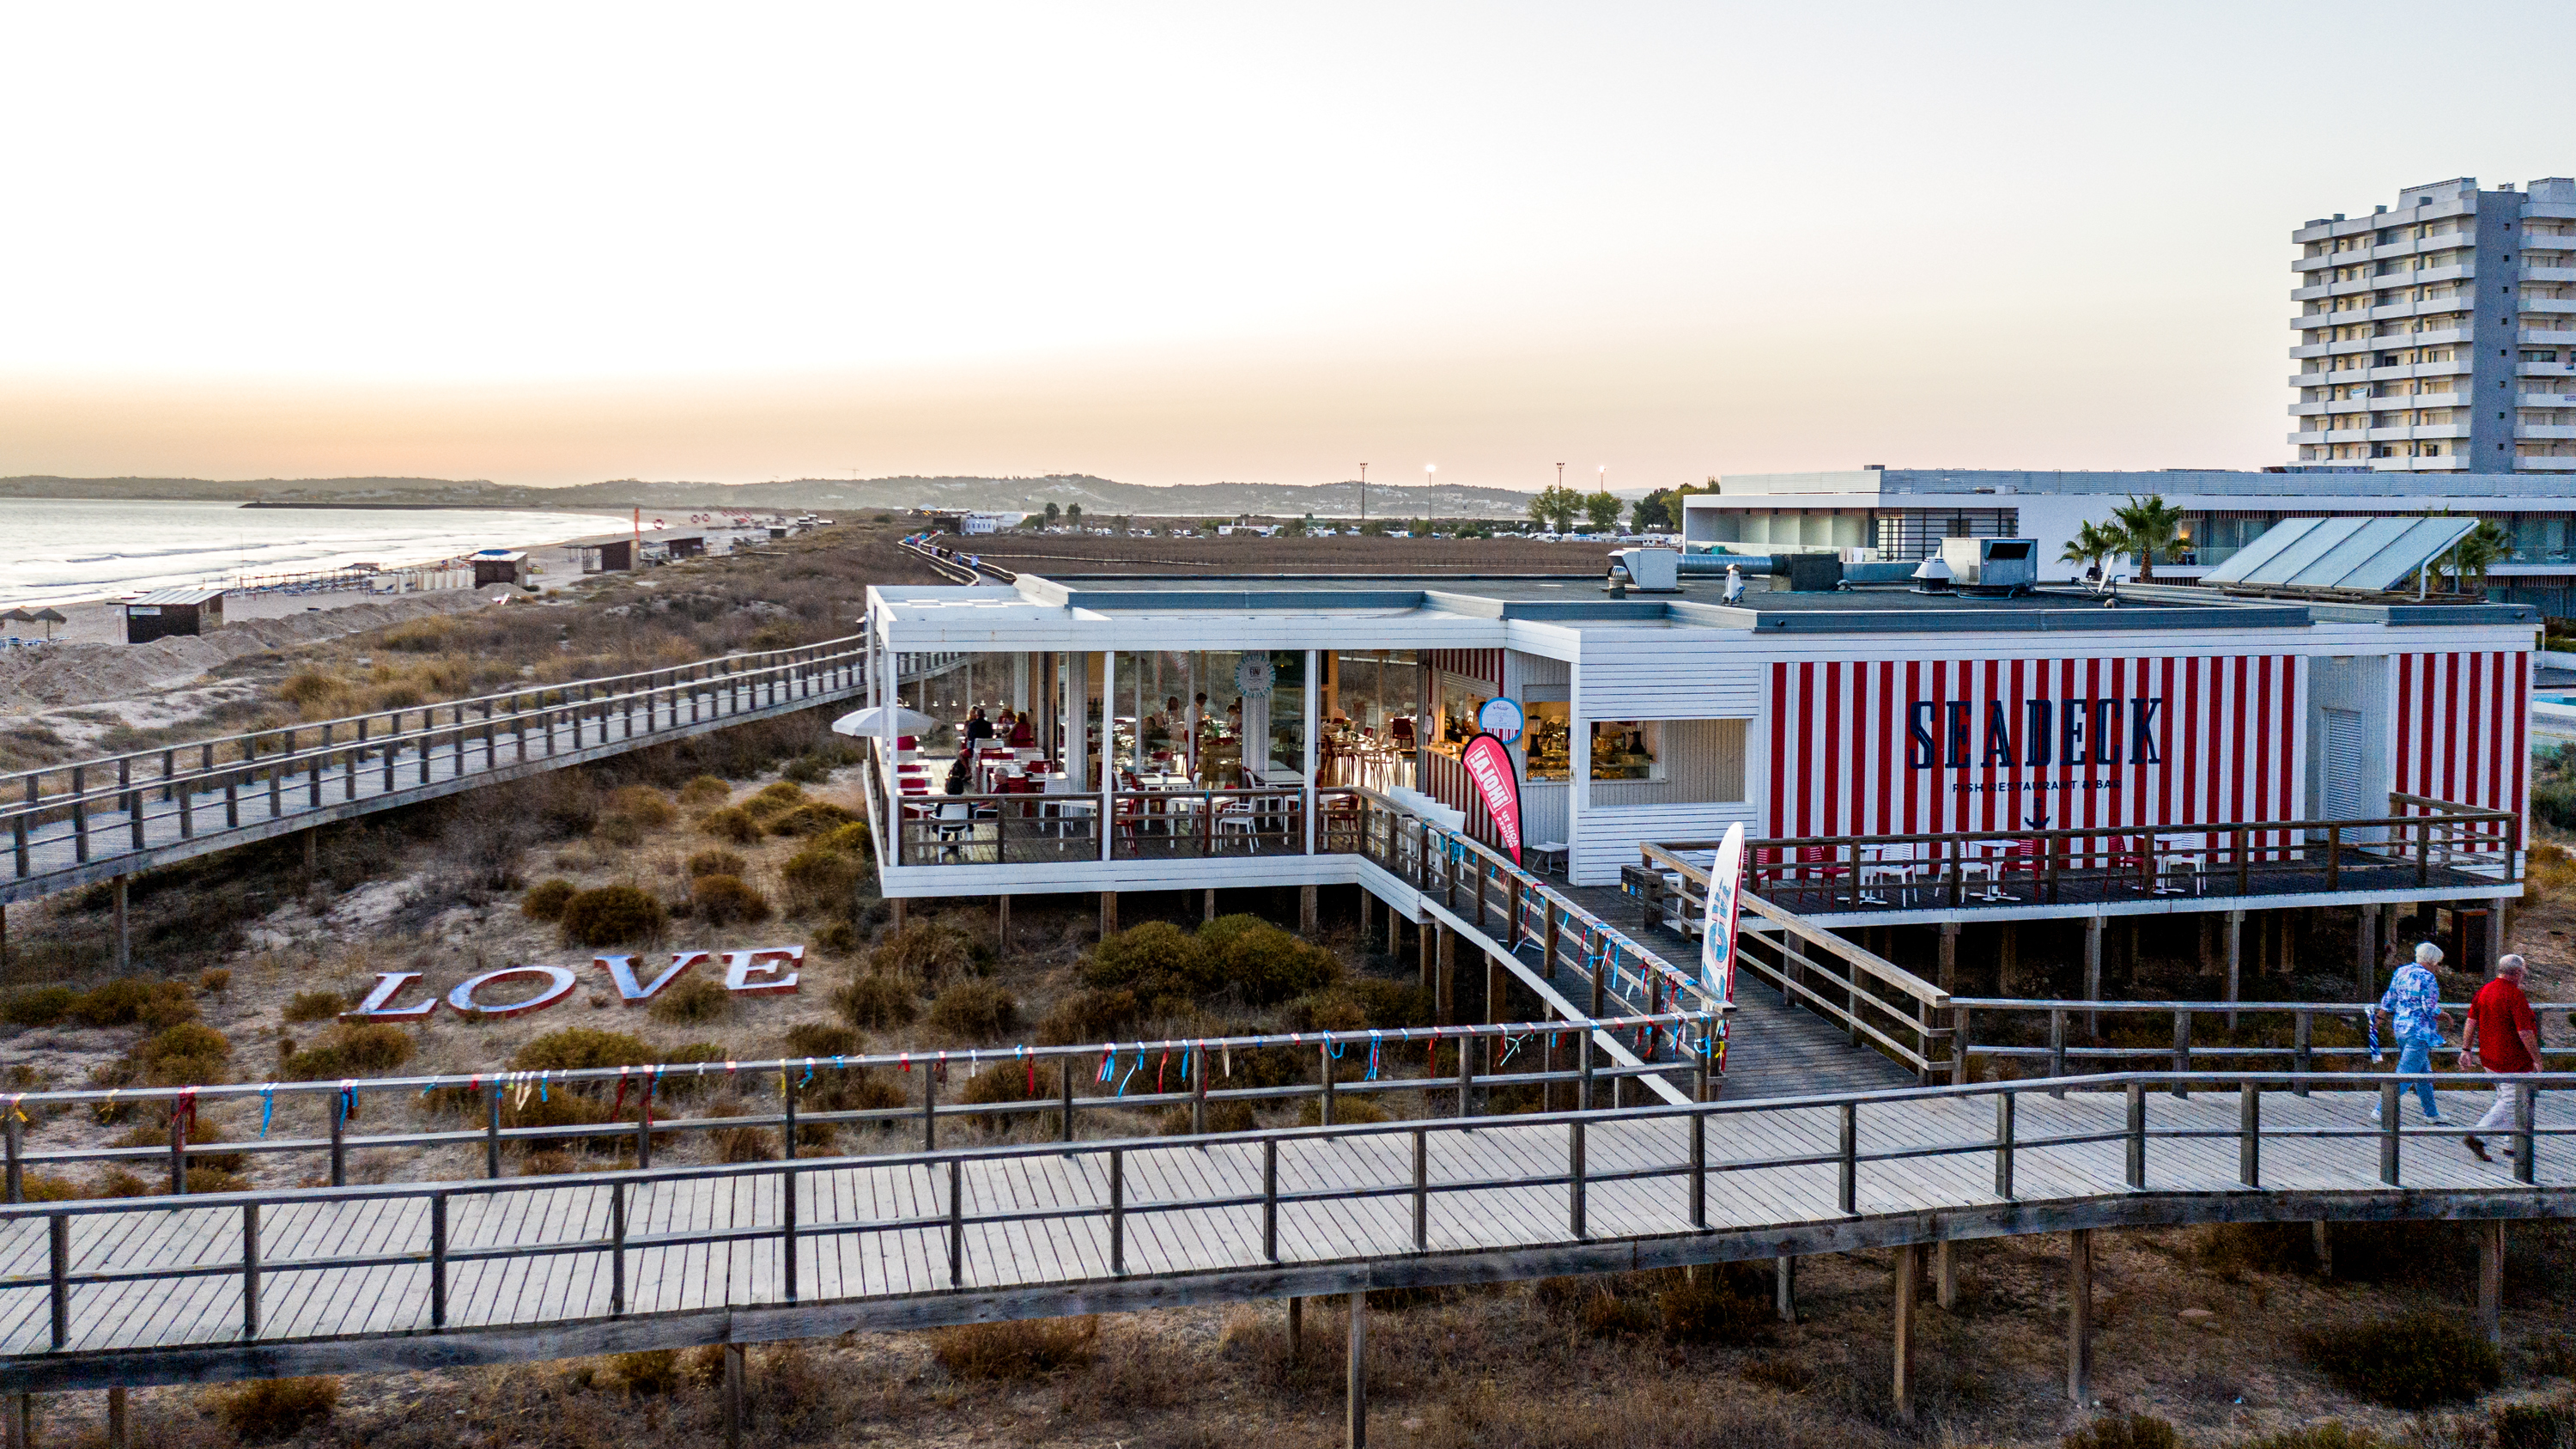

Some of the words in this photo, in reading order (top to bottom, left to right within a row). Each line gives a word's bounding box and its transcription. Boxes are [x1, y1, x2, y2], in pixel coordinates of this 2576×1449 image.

[1910, 698, 2162, 769] SEADECK
[1953, 783, 1984, 793] FISH
[1990, 780, 2078, 792] RESTAURANT
[2082, 781, 2090, 789] &
[2096, 779, 2122, 789] BAR
[338, 946, 805, 1024] LOVE
